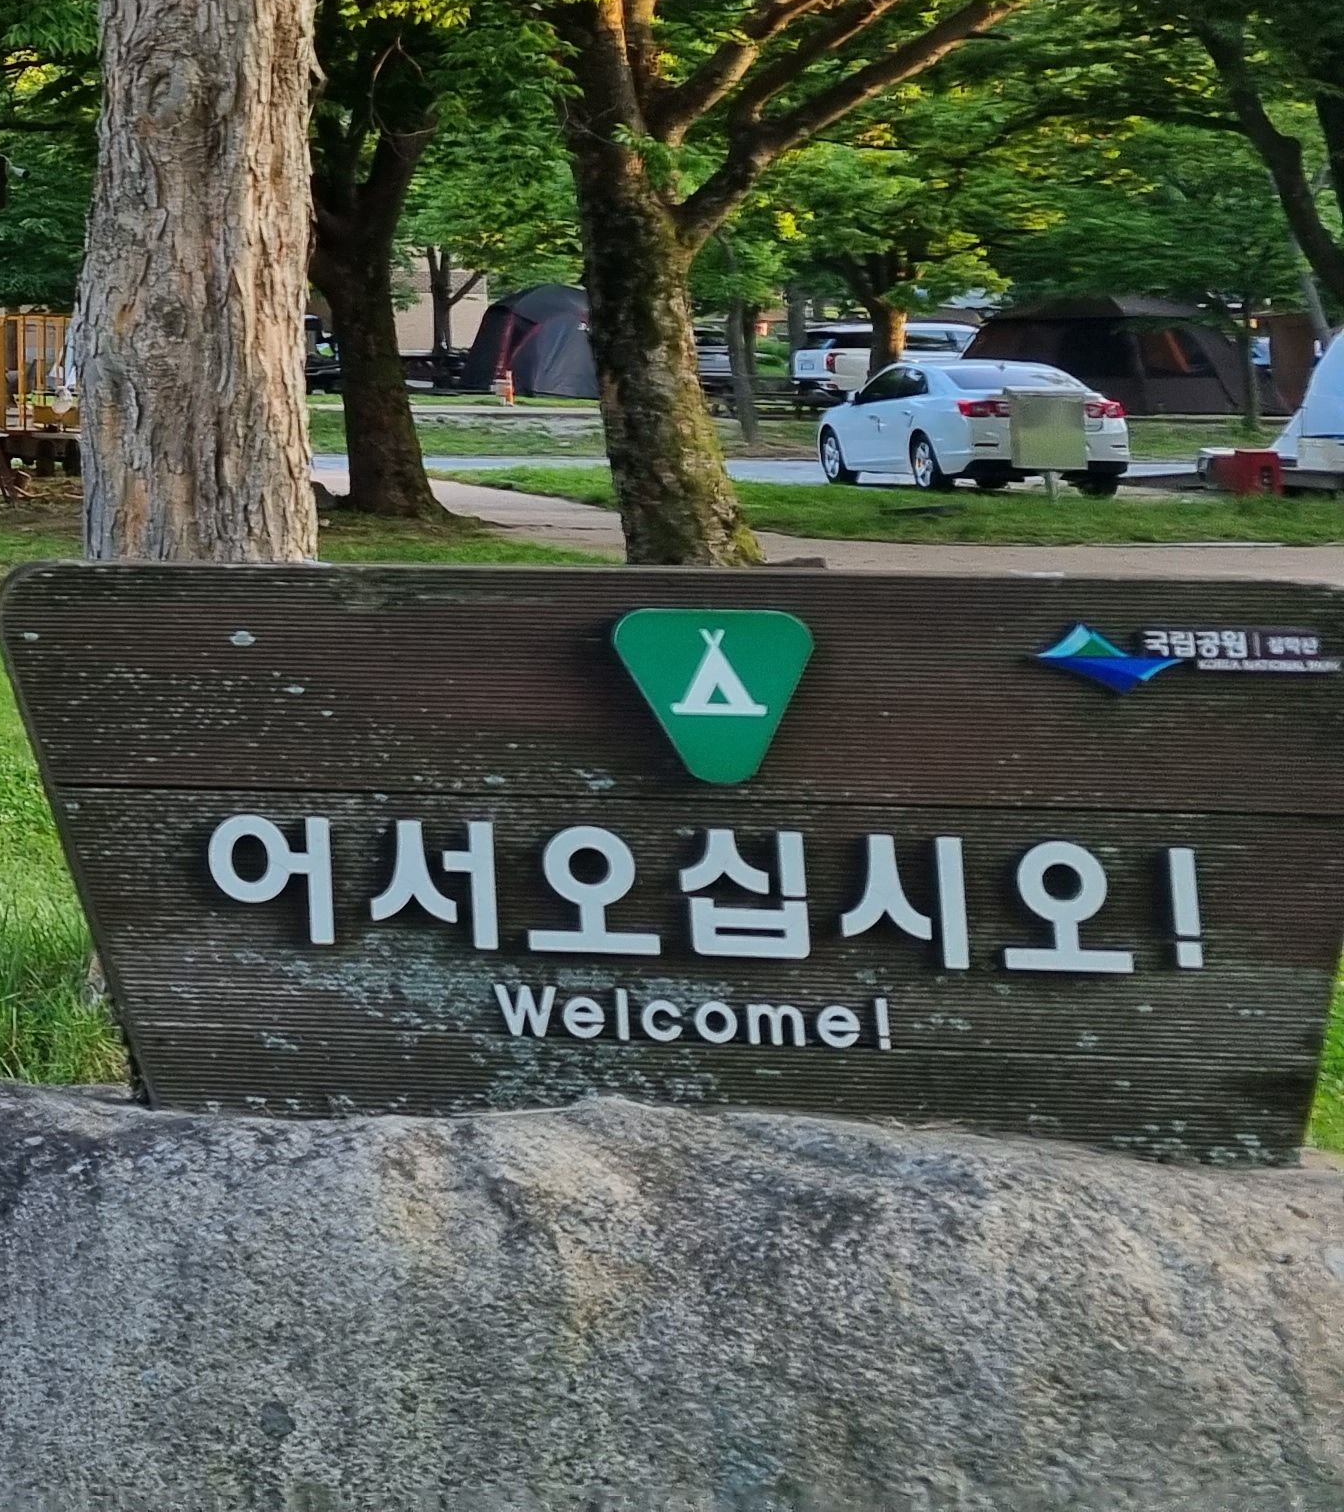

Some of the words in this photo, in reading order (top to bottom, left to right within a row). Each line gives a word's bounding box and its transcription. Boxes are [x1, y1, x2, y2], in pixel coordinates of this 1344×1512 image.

[1143, 630, 1248, 659] 국립공원
[1197, 658, 1241, 670] KOREA
[1241, 659, 1306, 671] NATIONAL
[207, 813, 1205, 975] 어서오십시오!
[493, 983, 893, 1051] Welcome!
